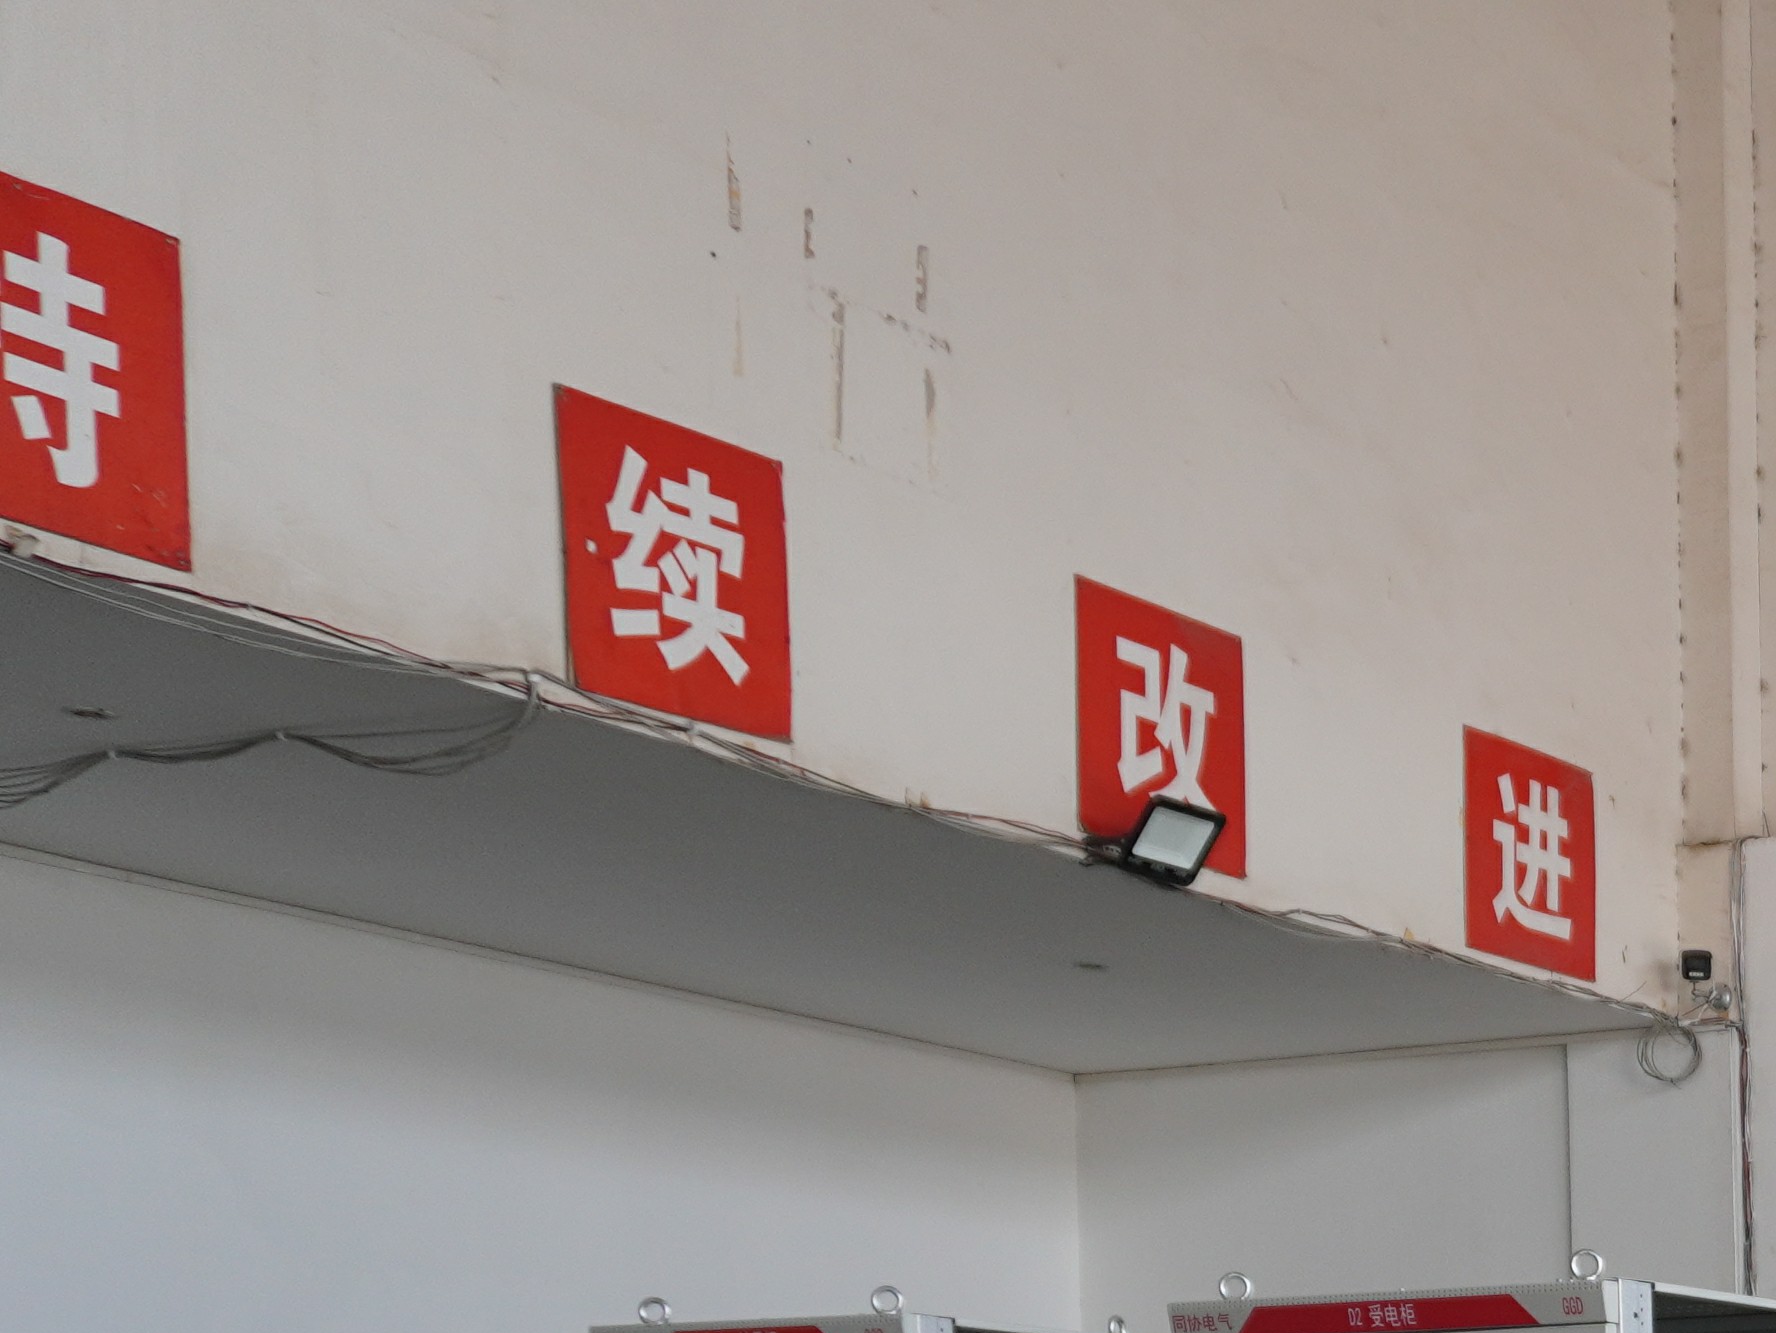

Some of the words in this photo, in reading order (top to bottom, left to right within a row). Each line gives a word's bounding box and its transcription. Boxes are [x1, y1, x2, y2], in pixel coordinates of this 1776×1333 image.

[1347, 1308, 1364, 1327] D2
[1370, 1302, 1416, 1329] 受电柜
[1562, 1295, 1584, 1316] GGD
[1172, 1313, 1233, 1333] 同协电气
